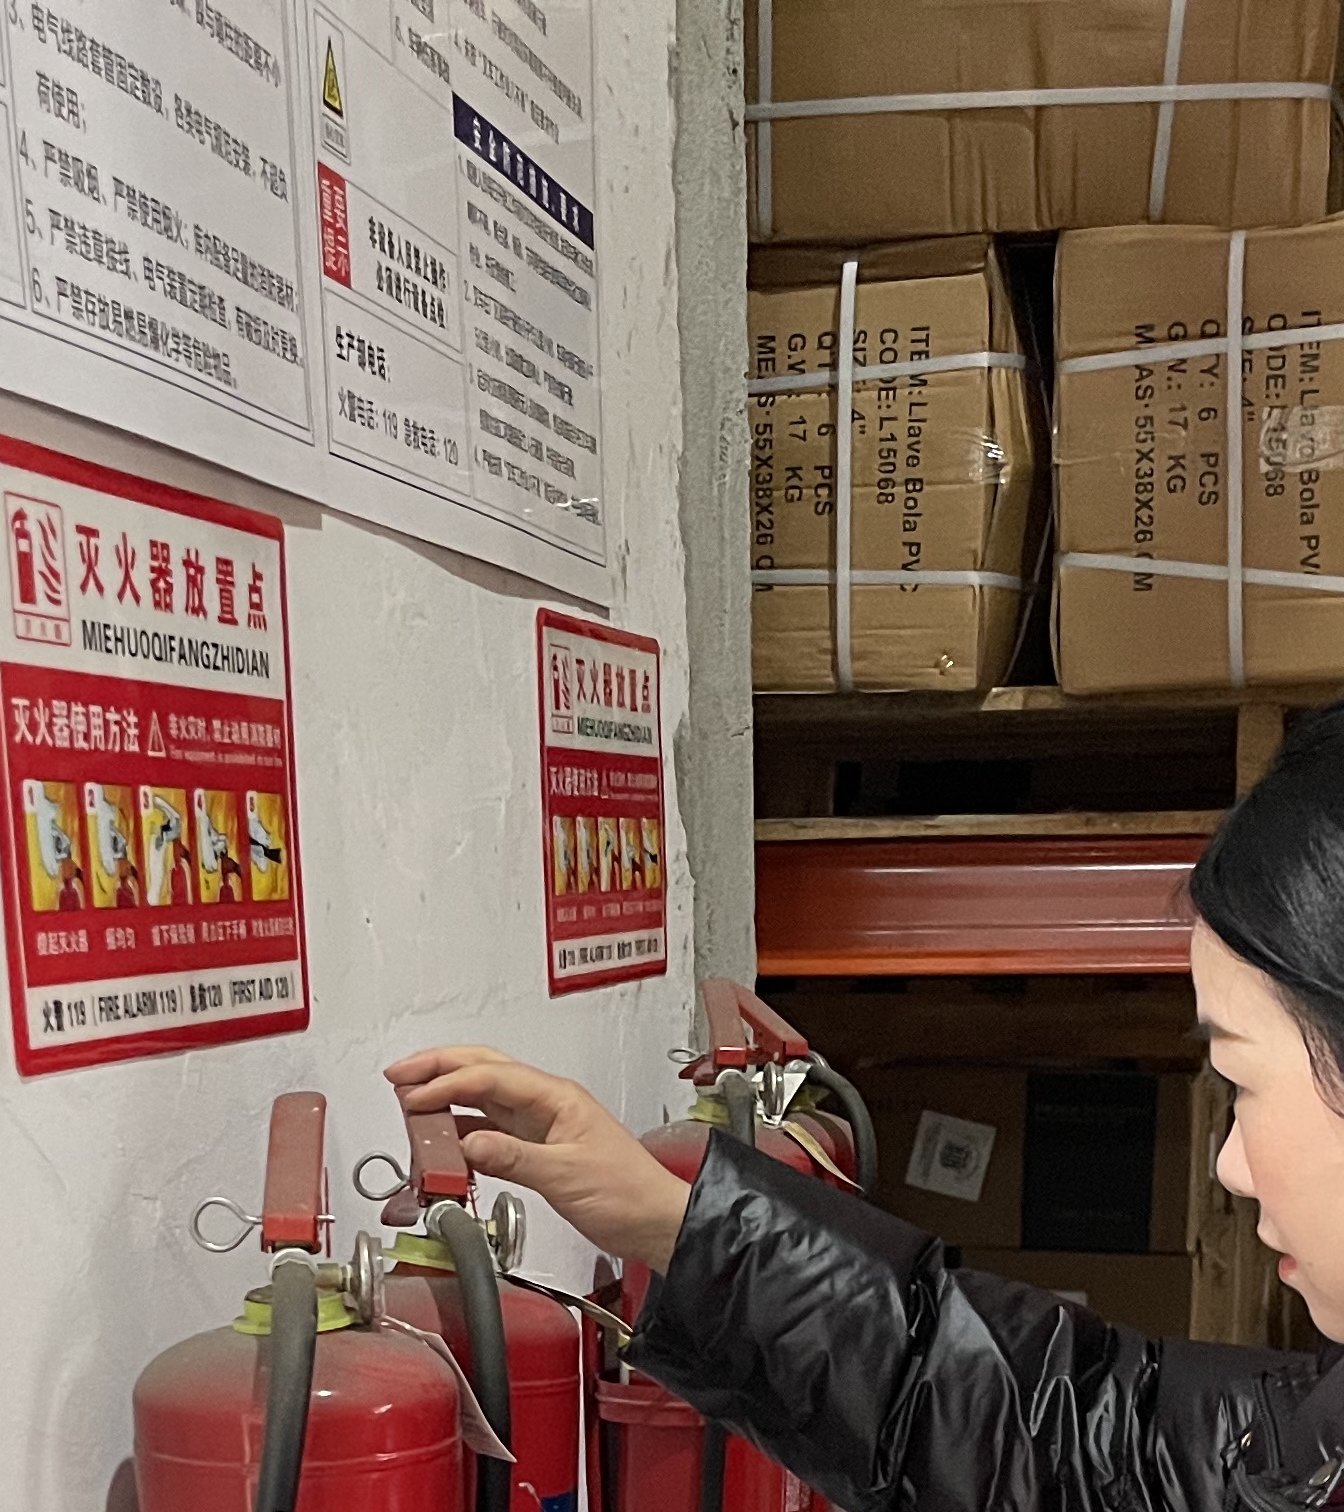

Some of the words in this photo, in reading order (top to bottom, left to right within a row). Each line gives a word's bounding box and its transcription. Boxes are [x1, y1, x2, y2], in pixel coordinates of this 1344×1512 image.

[1266, 314, 1286, 399] CDE:
[788, 416, 806, 442] 17
[818, 424, 834, 436] 6
[906, 402, 927, 467] Llave
[1168, 403, 1188, 430] 17
[1199, 408, 1217, 421] 6
[755, 424, 774, 545] 55X38X26
[785, 467, 802, 503] KG
[877, 417, 896, 505] L15068
[1134, 416, 1154, 543] 55X38X26
[1167, 455, 1186, 494] KG
[1198, 453, 1218, 506] PCS
[814, 465, 832, 516] PCS
[903, 478, 923, 532] Bola
[1300, 470, 1319, 526] Bola
[75, 523, 268, 632] 灭火器放置点
[1300, 536, 1320, 575] PV
[81, 620, 270, 680] MIEHUOQIFANGZHIDIAN
[10, 697, 140, 755] 灭火器使用方法
